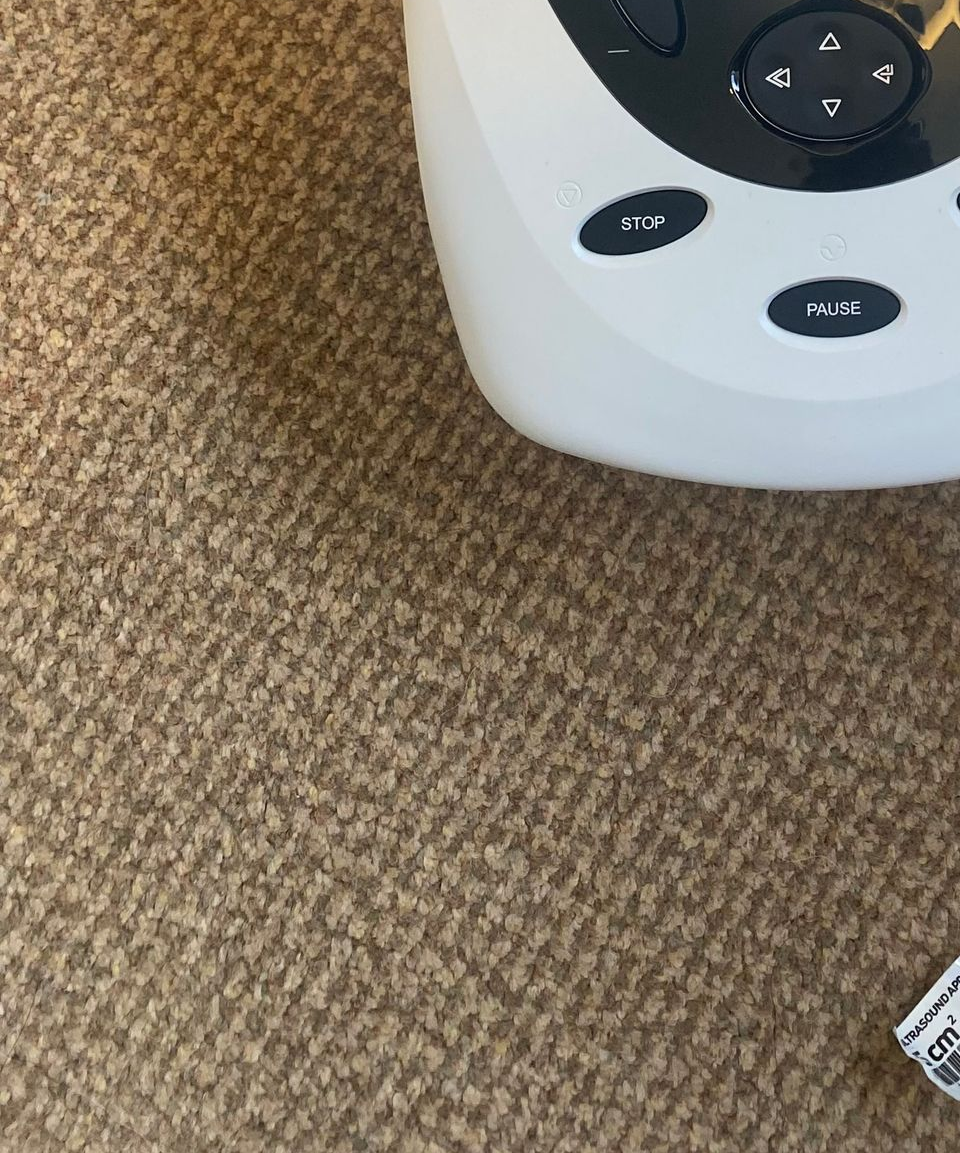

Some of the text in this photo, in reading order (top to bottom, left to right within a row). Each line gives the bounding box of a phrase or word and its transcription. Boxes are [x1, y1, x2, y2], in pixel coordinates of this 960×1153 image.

[620, 215, 666, 232] STOP
[806, 300, 862, 317] PAUSE
[902, 993, 950, 1047] LTRASOUND
